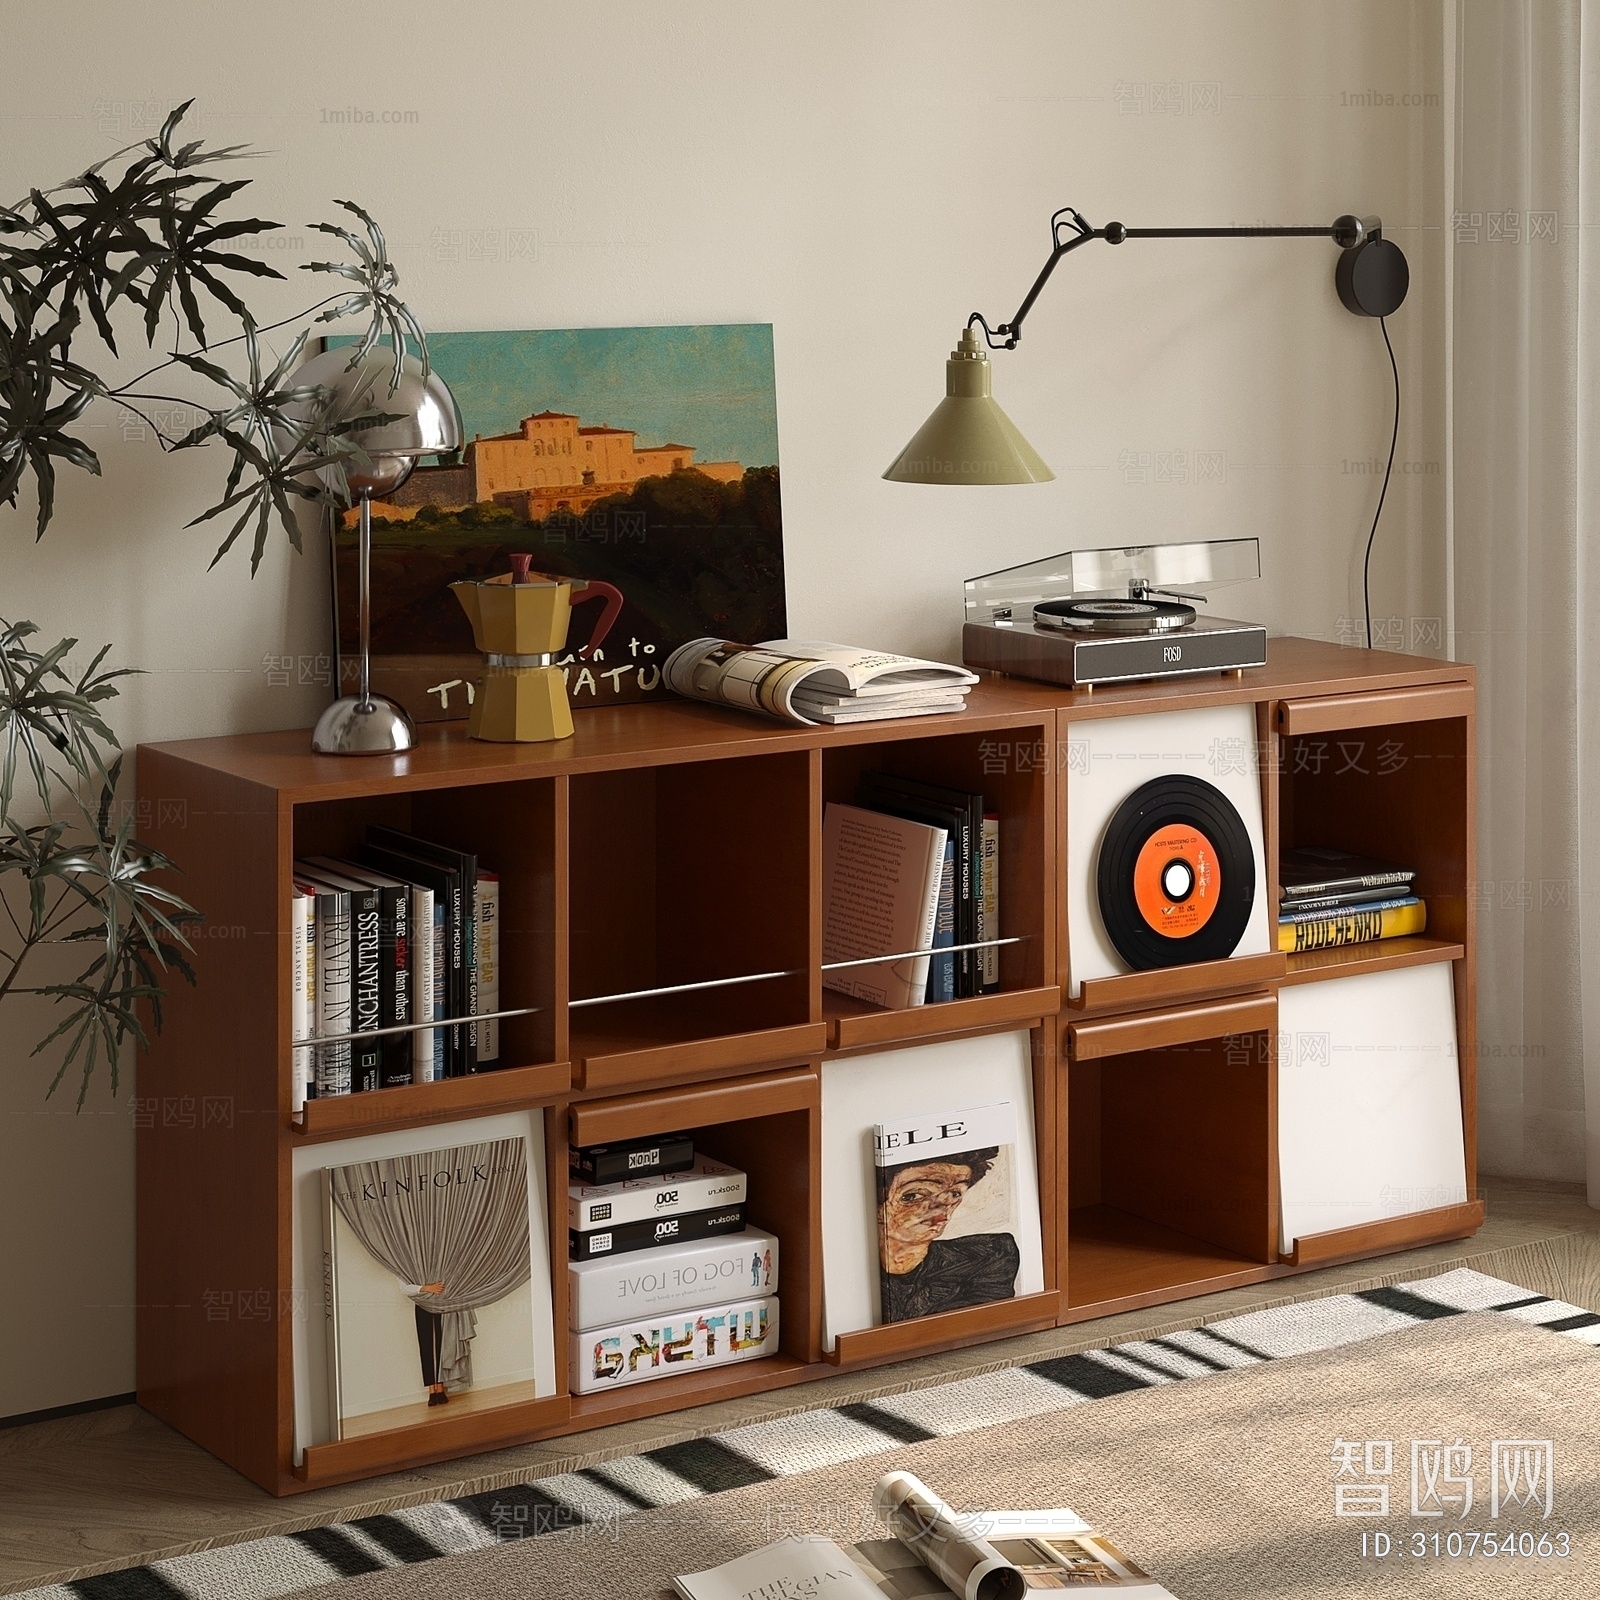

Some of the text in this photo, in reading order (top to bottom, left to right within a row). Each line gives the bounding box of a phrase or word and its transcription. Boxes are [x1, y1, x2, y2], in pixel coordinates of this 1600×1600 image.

[629, 638, 656, 657] to
[985, 839, 996, 858] fish
[931, 861, 942, 893] CROSSED
[984, 860, 994, 869] in
[962, 862, 970, 900] HOUSES
[982, 870, 994, 893] your
[481, 902, 495, 923] fish
[926, 904, 937, 930] CASTLE
[984, 894, 995, 914] EAR
[453, 888, 461, 969] LUXURY HOUSES
[481, 924, 494, 935] in
[323, 909, 351, 993] TRAVEL
[395, 897, 410, 1020] some are sicker than others
[479, 936, 493, 960] your
[357, 911, 379, 1033] NCHANTRESS
[481, 961, 494, 983] EAR
[423, 976, 431, 1002] CASTLE
[469, 985, 477, 1015] GRAND
[323, 999, 351, 1022] IN
[469, 1020, 477, 1047] ESIGN
[362, 1164, 488, 1202] KINFOLK
[323, 1250, 332, 1322] KINFOLK
